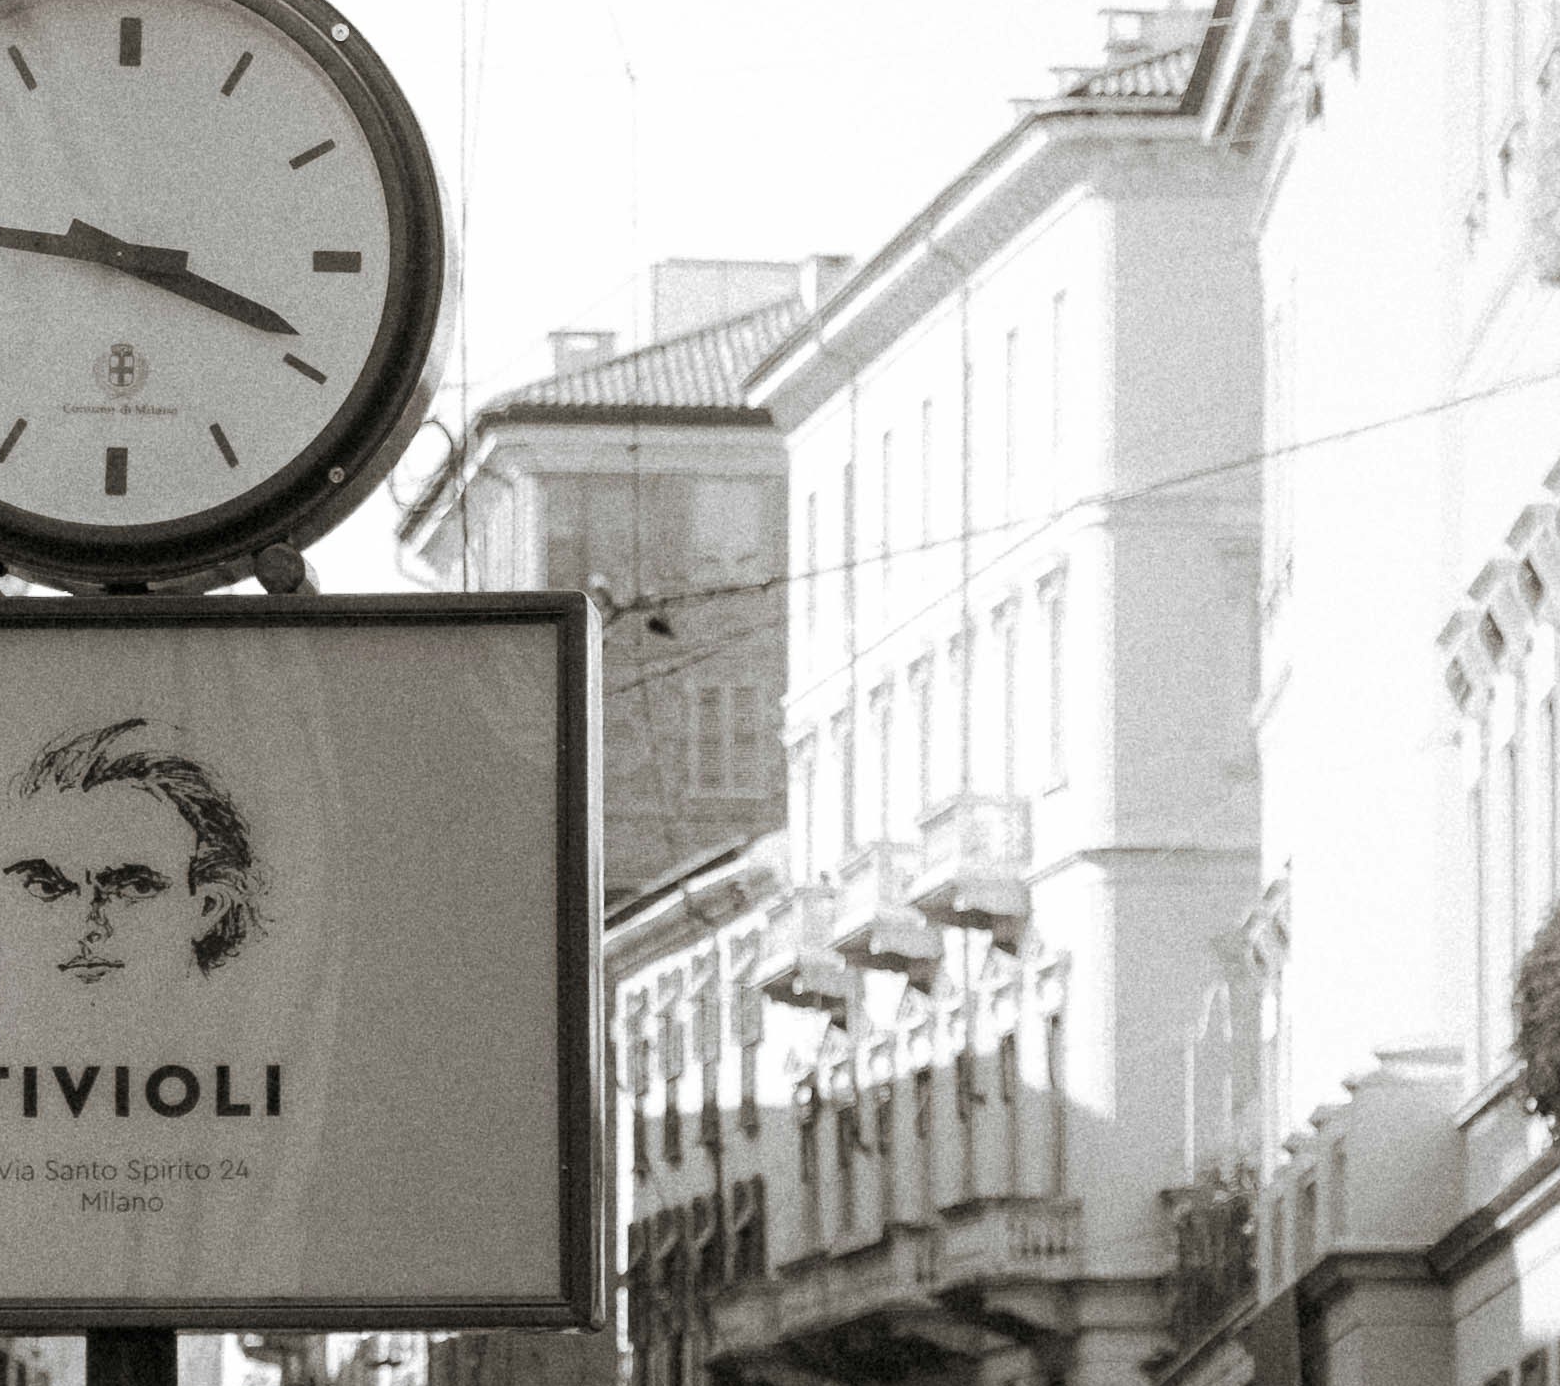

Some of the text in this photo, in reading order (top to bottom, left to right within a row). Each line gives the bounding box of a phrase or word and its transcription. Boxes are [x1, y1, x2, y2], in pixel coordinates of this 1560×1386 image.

[44, 1159, 118, 1182] Santo
[126, 1157, 210, 1186] Spirito
[218, 1158, 250, 1181] 24
[81, 1190, 164, 1213] Milano
